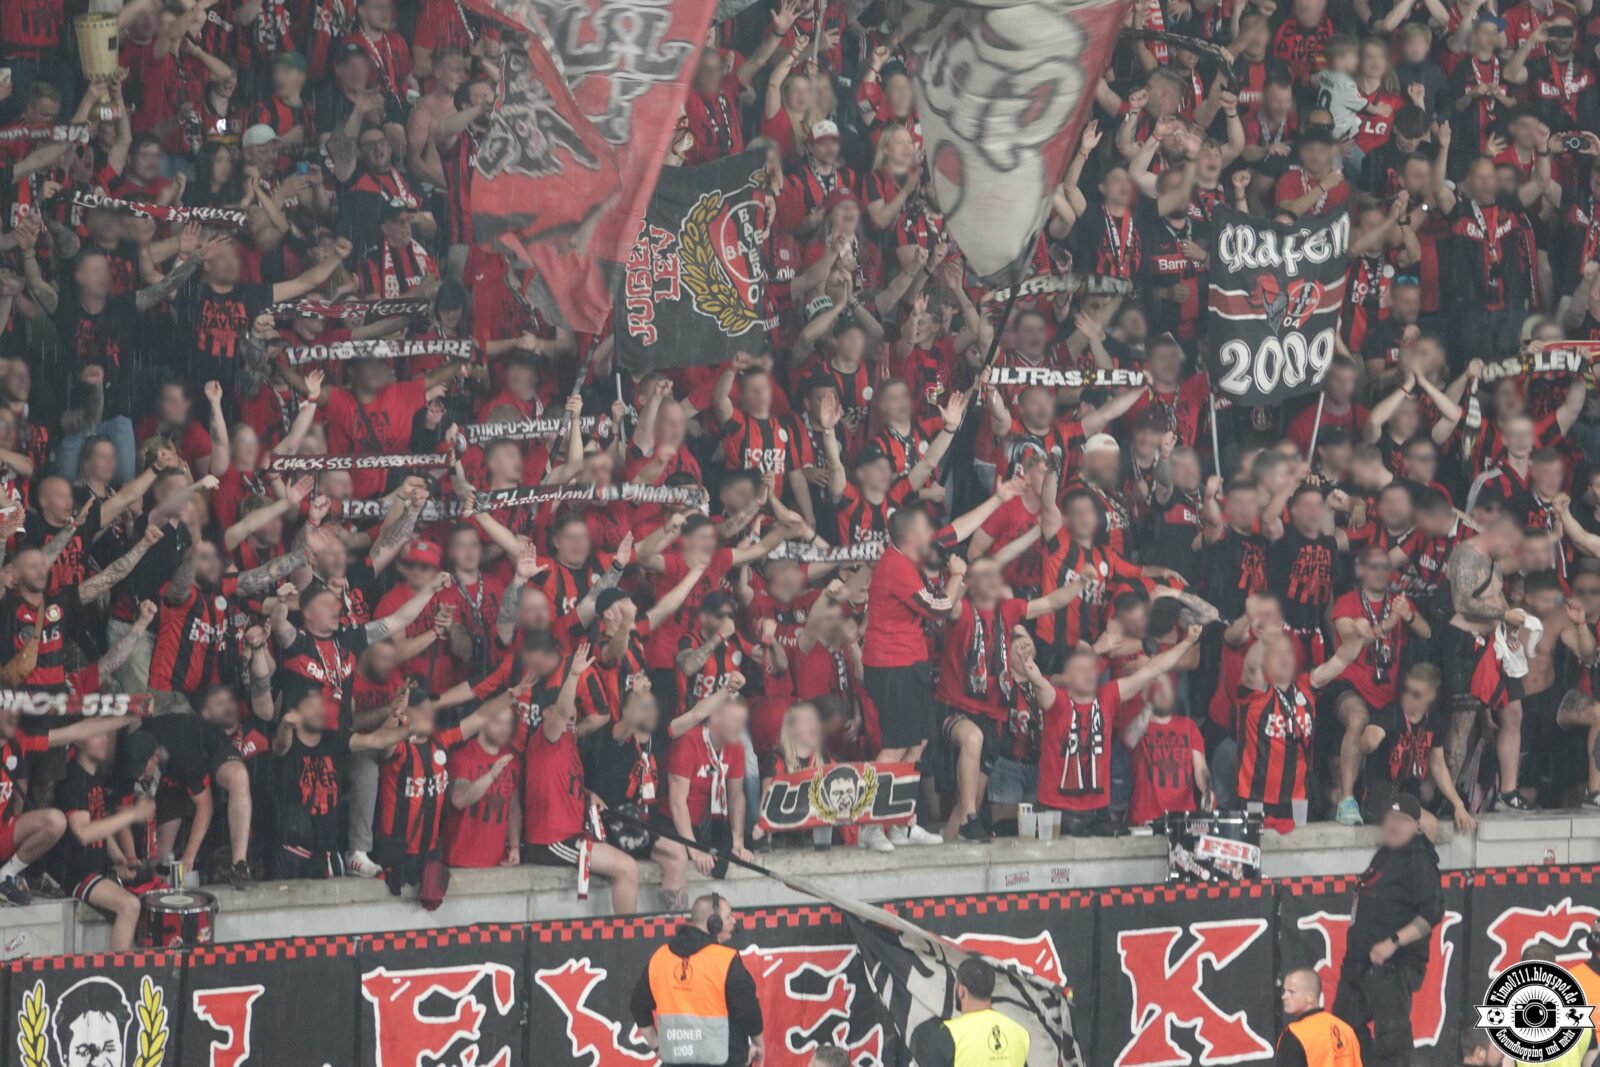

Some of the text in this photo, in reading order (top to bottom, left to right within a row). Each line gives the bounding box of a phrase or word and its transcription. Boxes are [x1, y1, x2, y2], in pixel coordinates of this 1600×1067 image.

[1218, 327, 1336, 396] 2009
[1534, 347, 1582, 372] LEV
[1094, 368, 1145, 386] LEV
